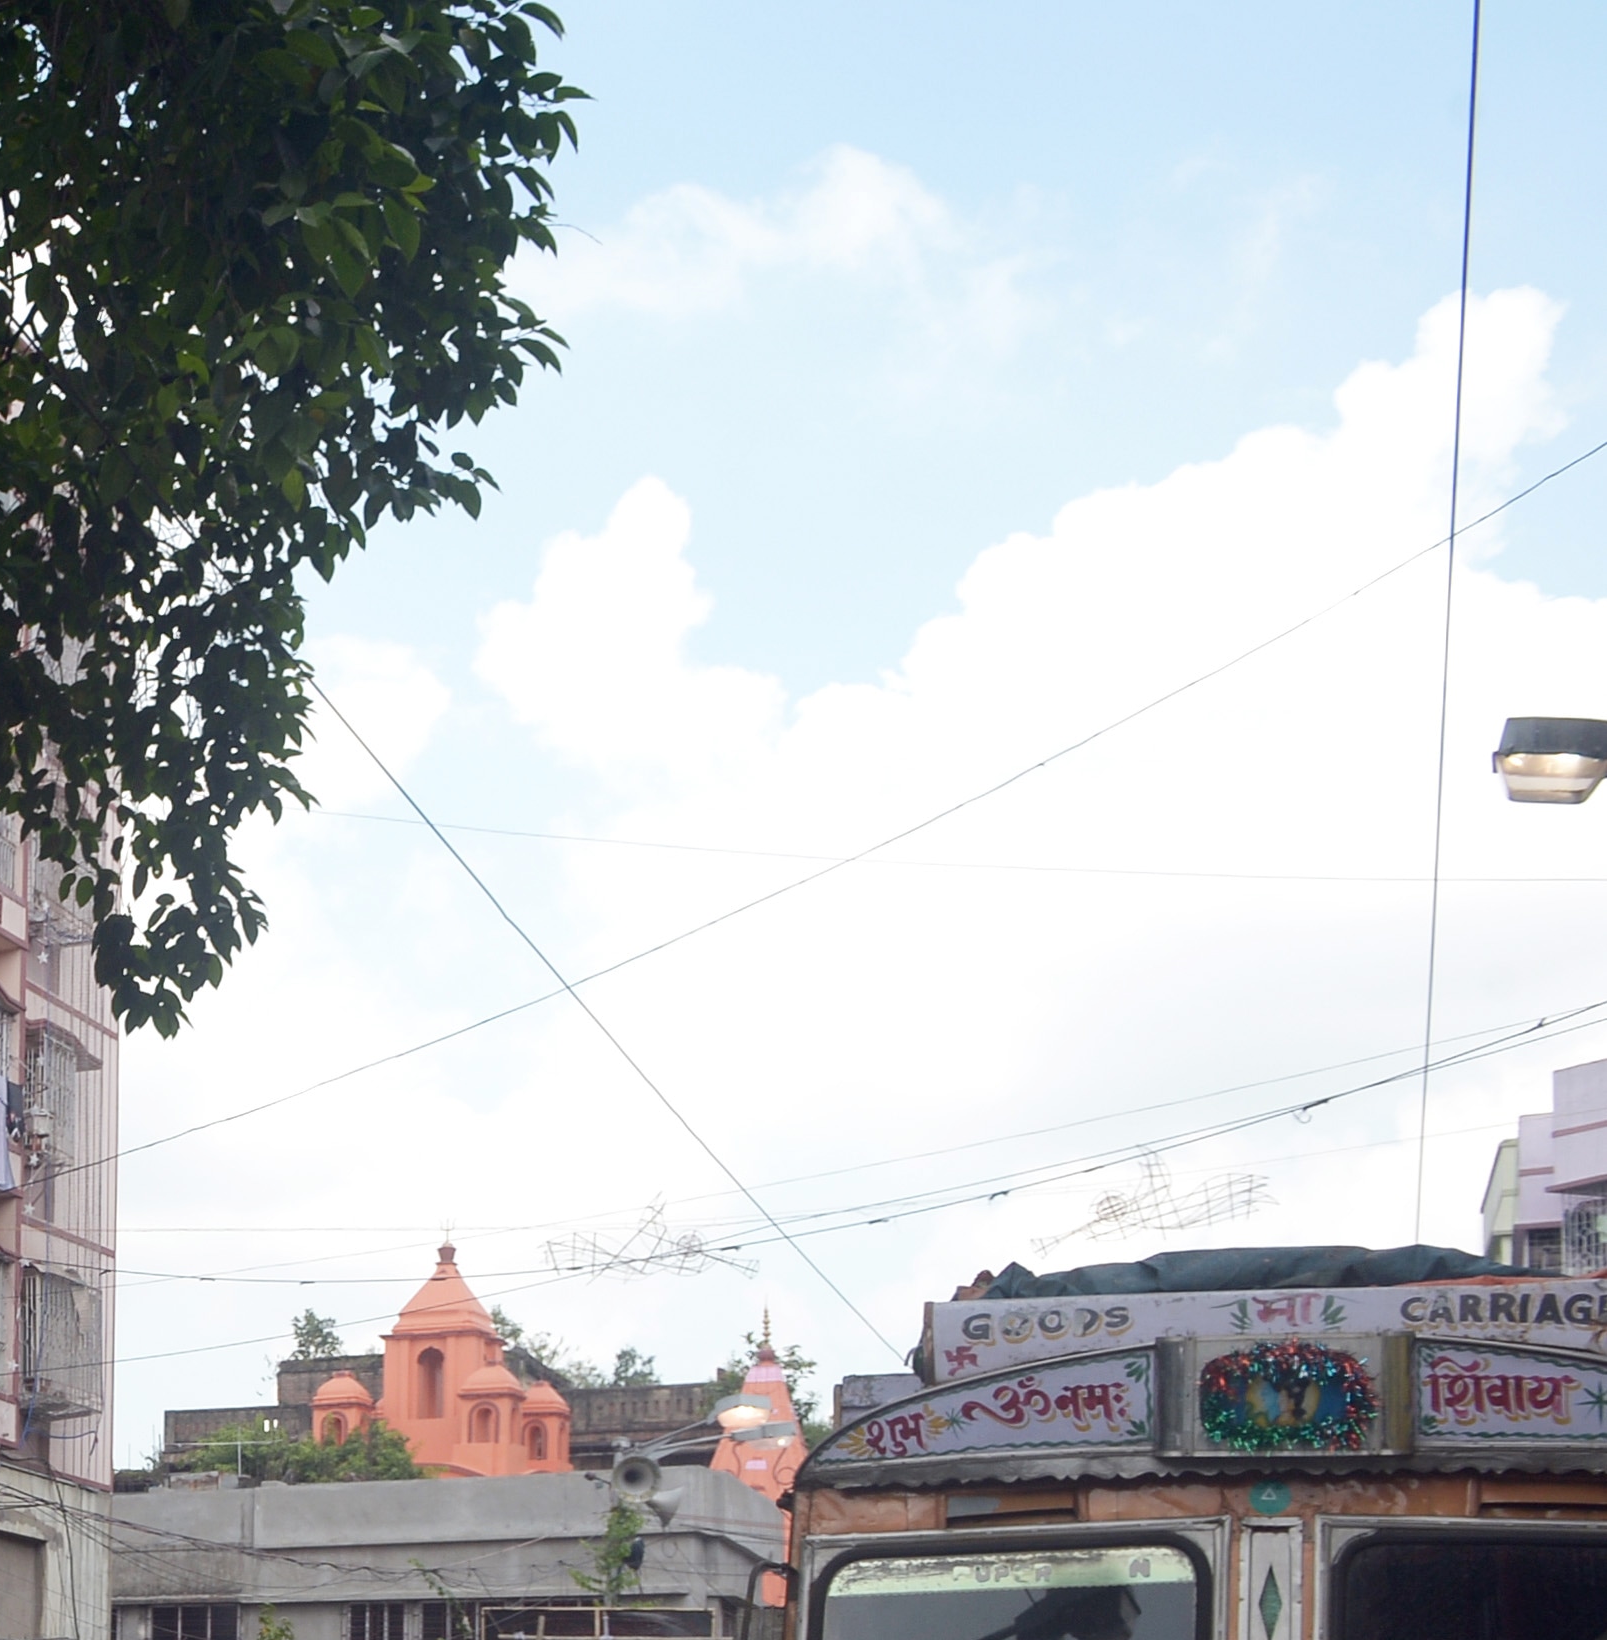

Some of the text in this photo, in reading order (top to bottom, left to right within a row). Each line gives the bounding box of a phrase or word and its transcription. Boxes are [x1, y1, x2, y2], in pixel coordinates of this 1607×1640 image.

[960, 1305, 1133, 1346] GOODS
[1252, 1292, 1322, 1327] मा
[1053, 1381, 1131, 1423] नमः
[865, 1412, 929, 1456] शुभ
